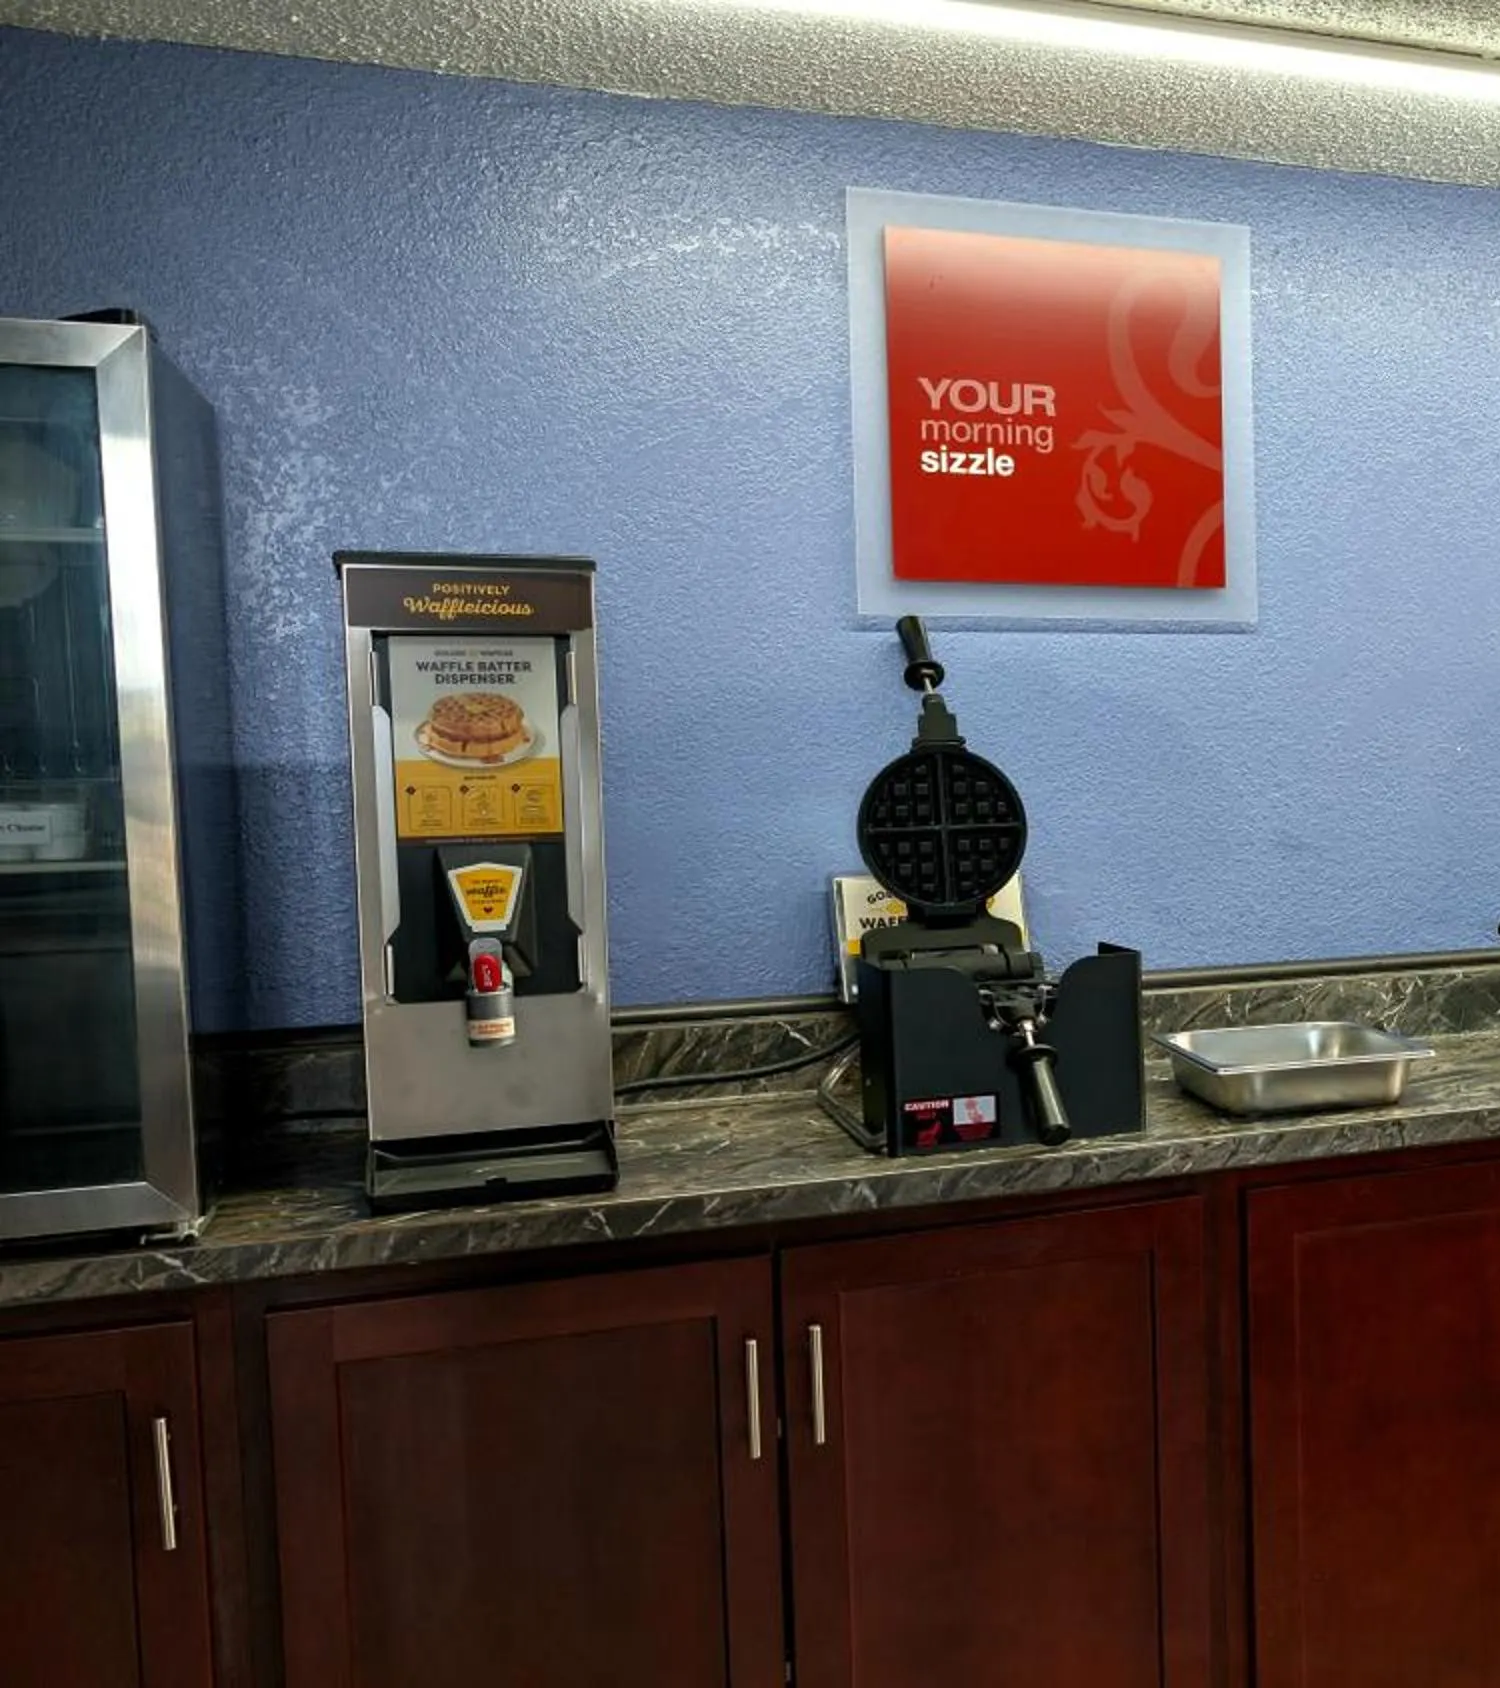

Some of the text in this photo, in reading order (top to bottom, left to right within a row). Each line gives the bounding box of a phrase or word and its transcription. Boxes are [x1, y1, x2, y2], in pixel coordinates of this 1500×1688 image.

[918, 377, 1056, 417] YOUR
[921, 417, 1053, 453] morning
[920, 444, 1014, 477] sizzle
[432, 583, 510, 595] POSITIVELY
[416, 661, 532, 673] WAFFLE BATTER
[435, 673, 515, 685] DISPENSER
[904, 1100, 949, 1111] CAUTION
